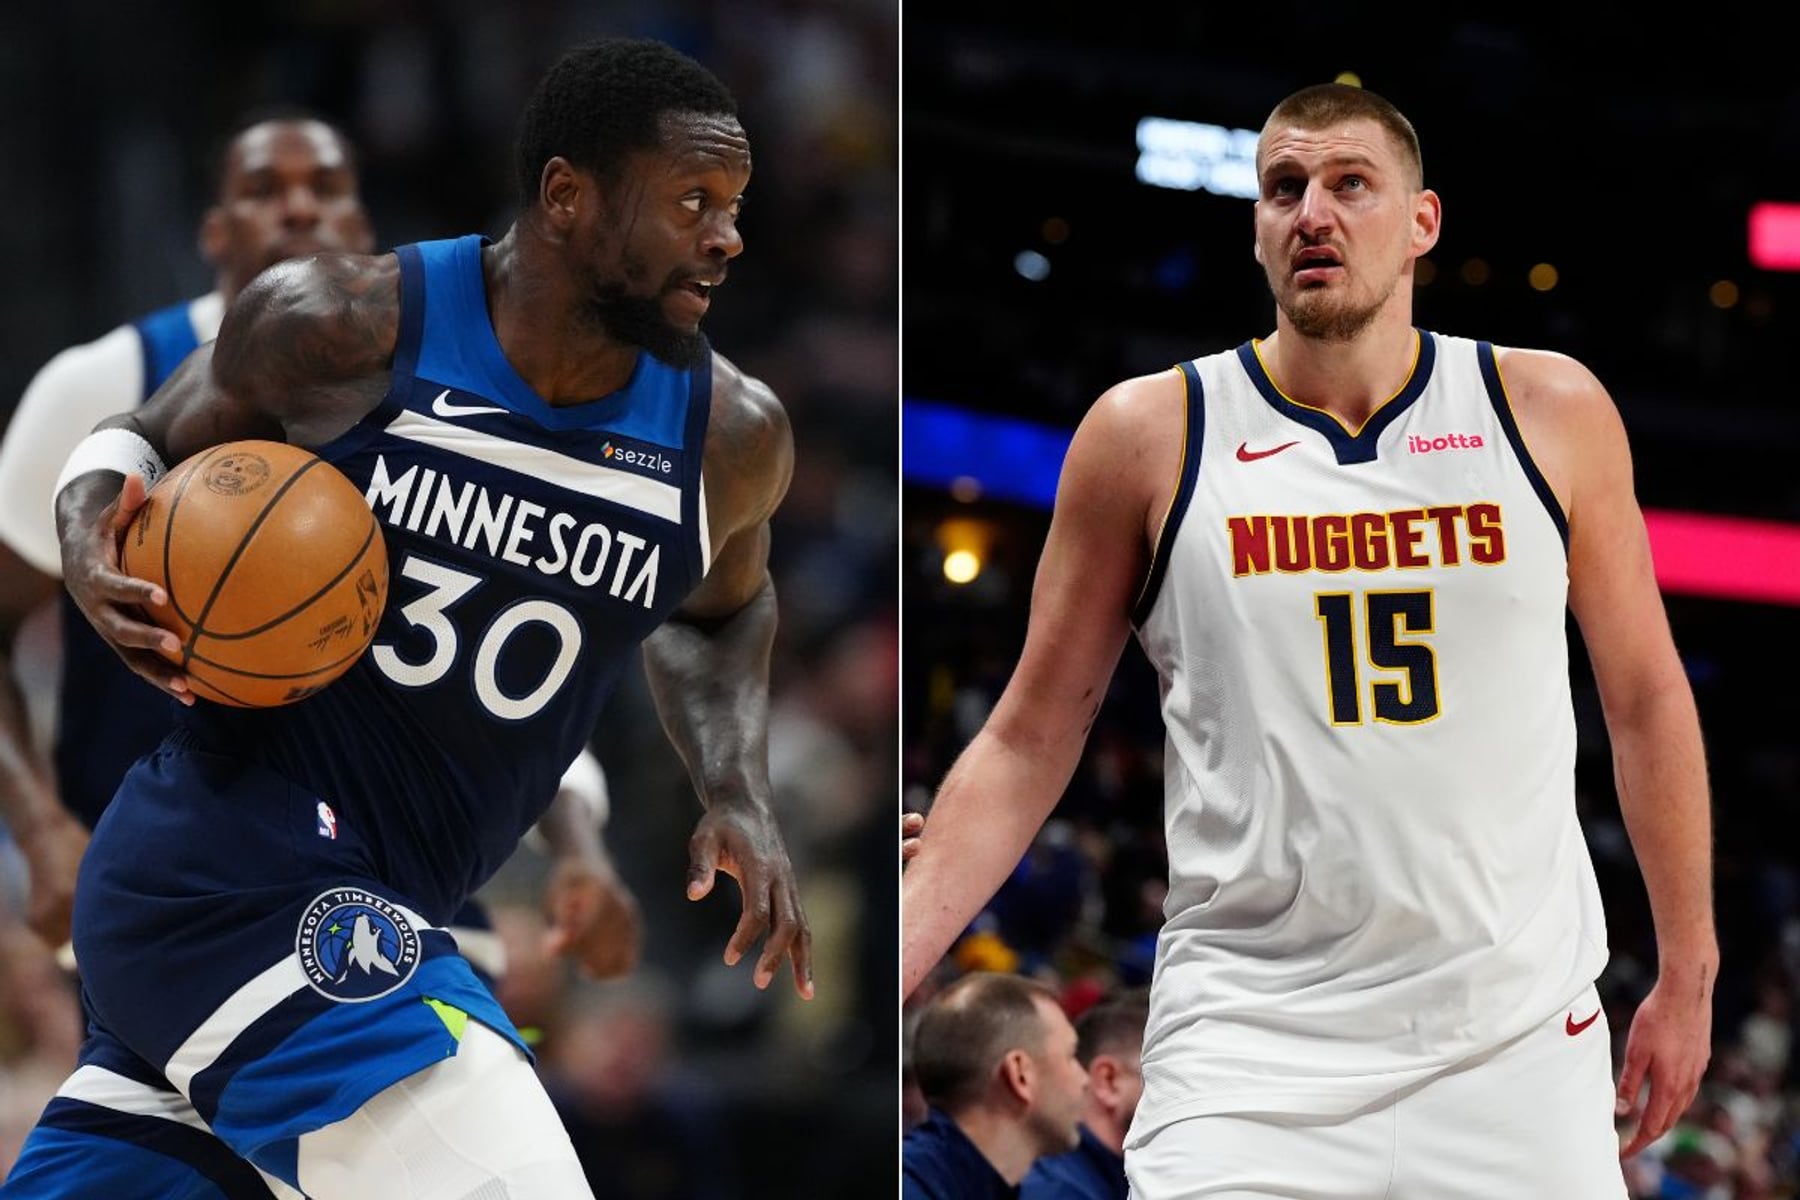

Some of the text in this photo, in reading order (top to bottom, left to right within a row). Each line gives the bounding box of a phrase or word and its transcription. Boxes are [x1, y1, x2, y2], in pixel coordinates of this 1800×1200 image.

[615, 448, 672, 473] sezzle
[1408, 433, 1483, 454] ibotta
[364, 454, 660, 609] MINNESOTA
[1226, 502, 1508, 578] NUGGETS
[372, 556, 583, 720] 30
[1314, 588, 1442, 727] 15
[301, 892, 416, 984] MINNESOTA TIMBERWOLVES
